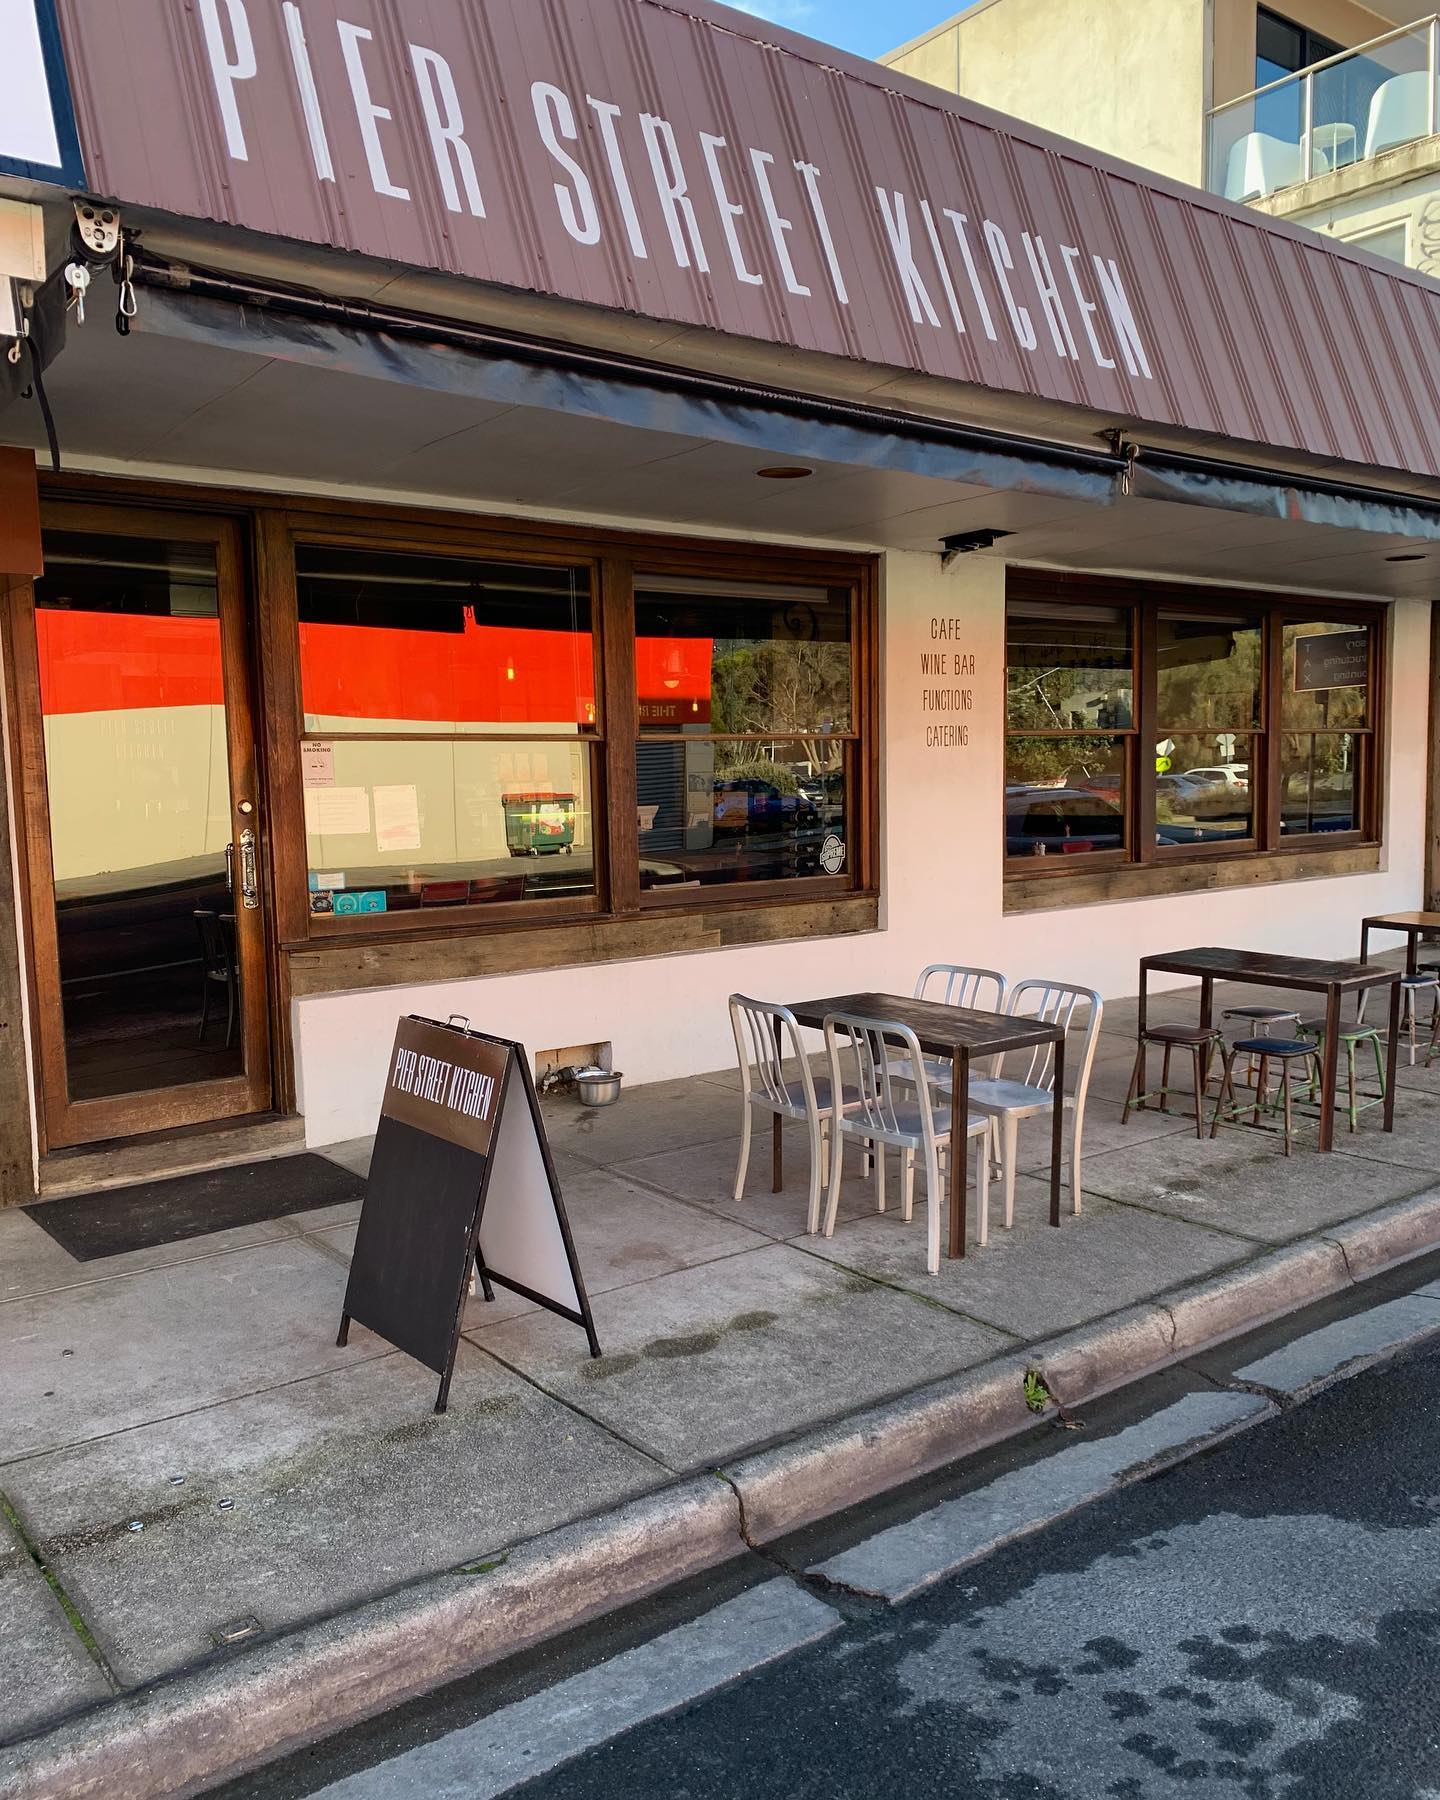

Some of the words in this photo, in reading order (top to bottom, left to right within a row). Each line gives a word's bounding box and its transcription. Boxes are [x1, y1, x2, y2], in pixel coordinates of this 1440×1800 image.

[199, 0, 487, 219] PIER
[530, 81, 849, 305] STREET
[875, 185, 1153, 381] KITCHEN
[930, 618, 961, 640] CAFE
[920, 653, 947, 675] WINE
[954, 654, 975, 675] BAR
[923, 690, 973, 711] FUNCTIONS
[926, 725, 969, 747] CATERING
[392, 1047, 417, 1093] PIER
[414, 1054, 452, 1105] STREET
[447, 1064, 495, 1121] KITCHEN
